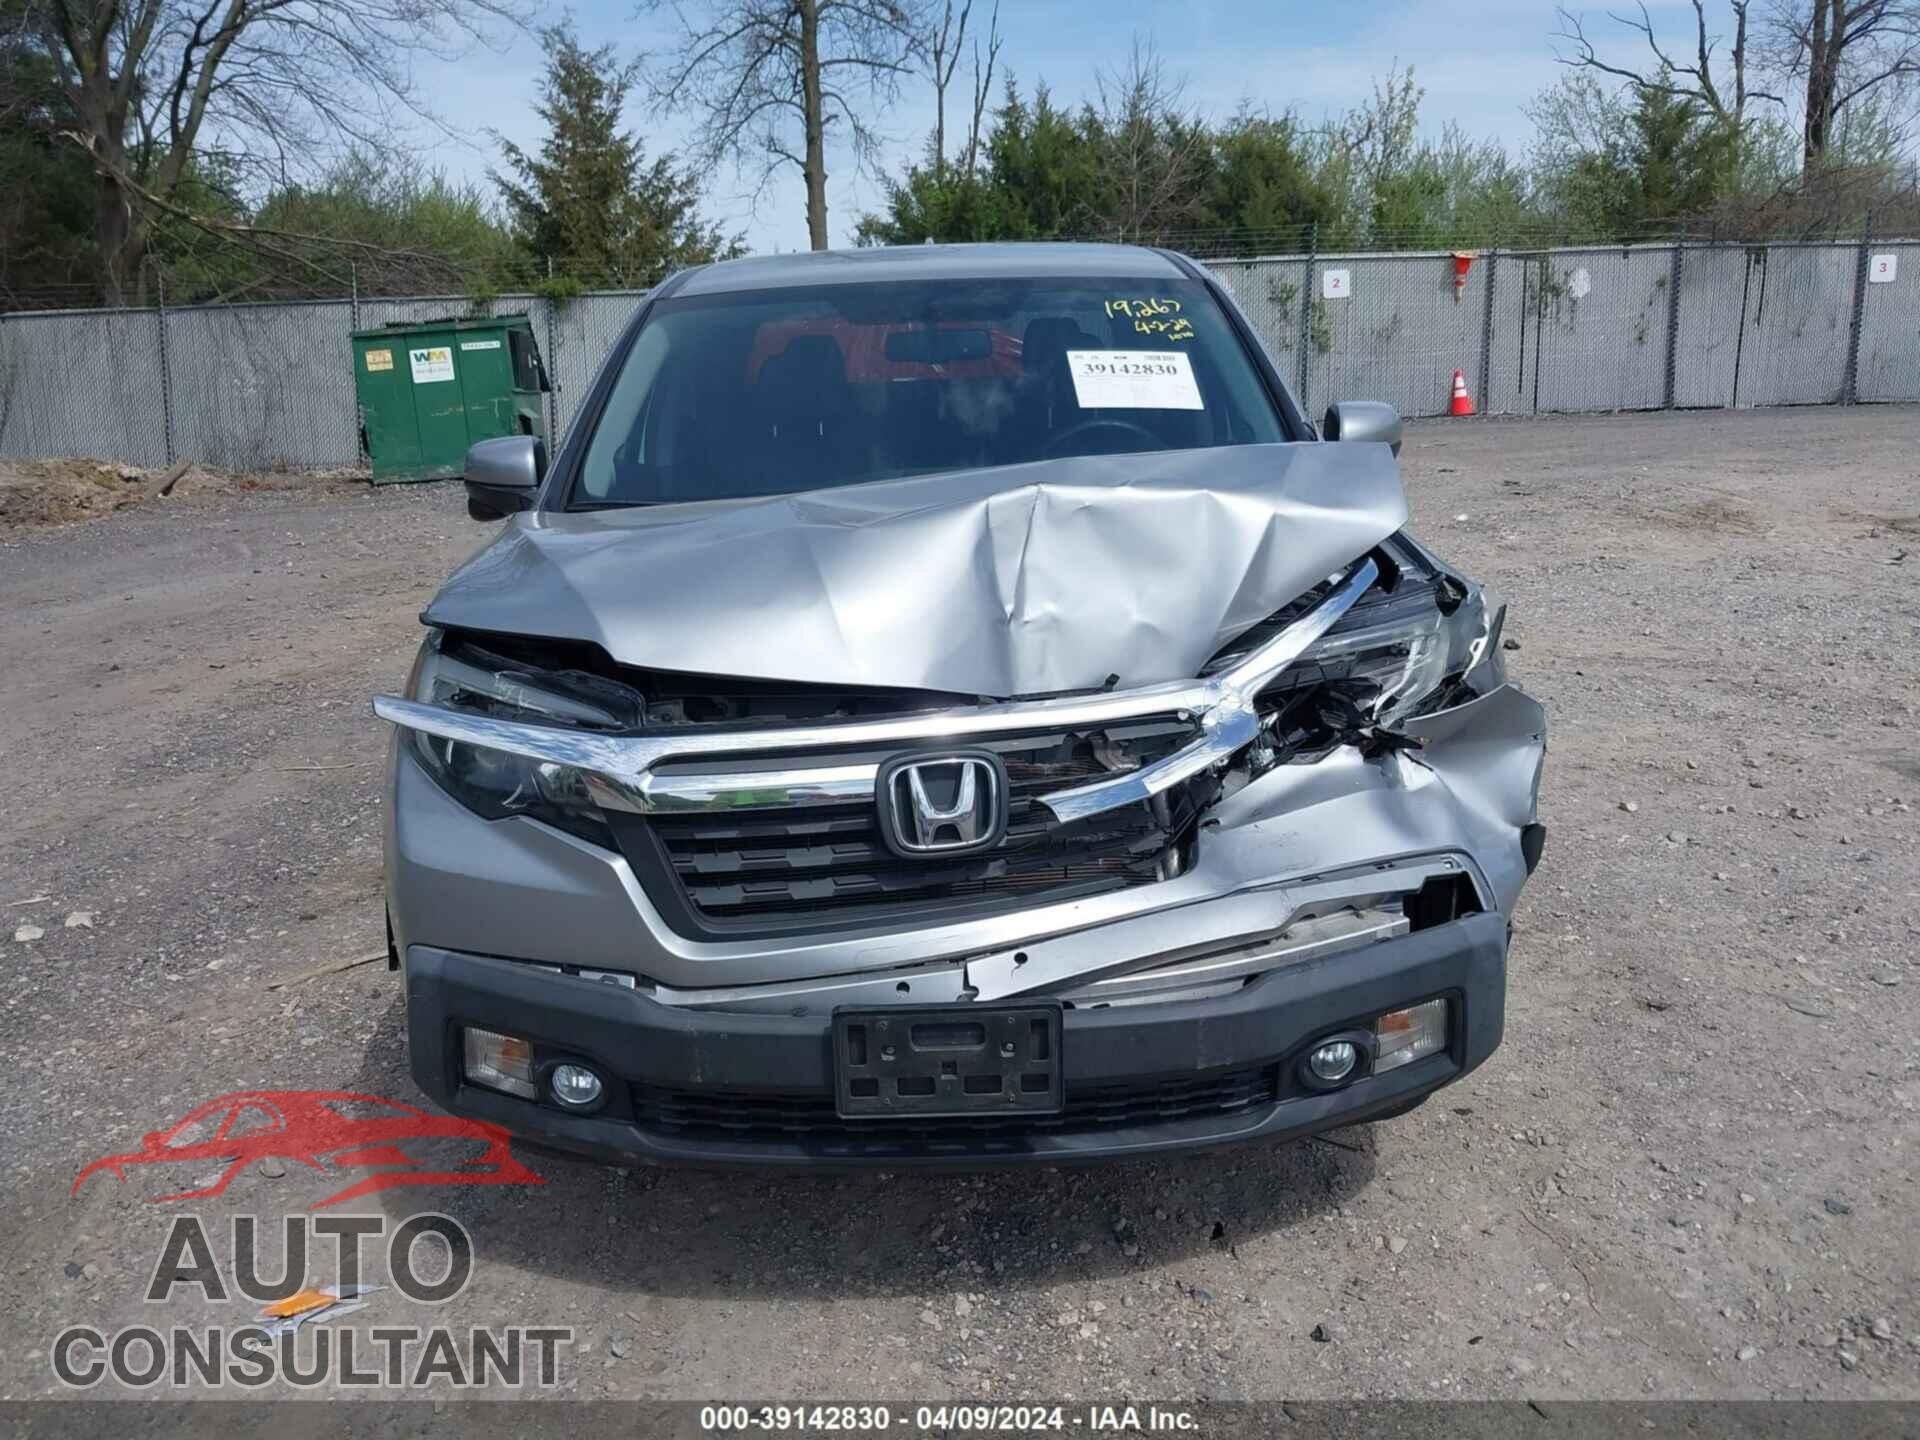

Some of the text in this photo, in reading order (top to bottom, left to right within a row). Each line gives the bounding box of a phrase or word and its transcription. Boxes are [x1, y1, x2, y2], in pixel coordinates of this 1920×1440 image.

[1879, 262, 1888, 273] 3
[1332, 277, 1341, 288] 2
[413, 351, 447, 363] WM
[1083, 363, 1178, 376] 39142830
